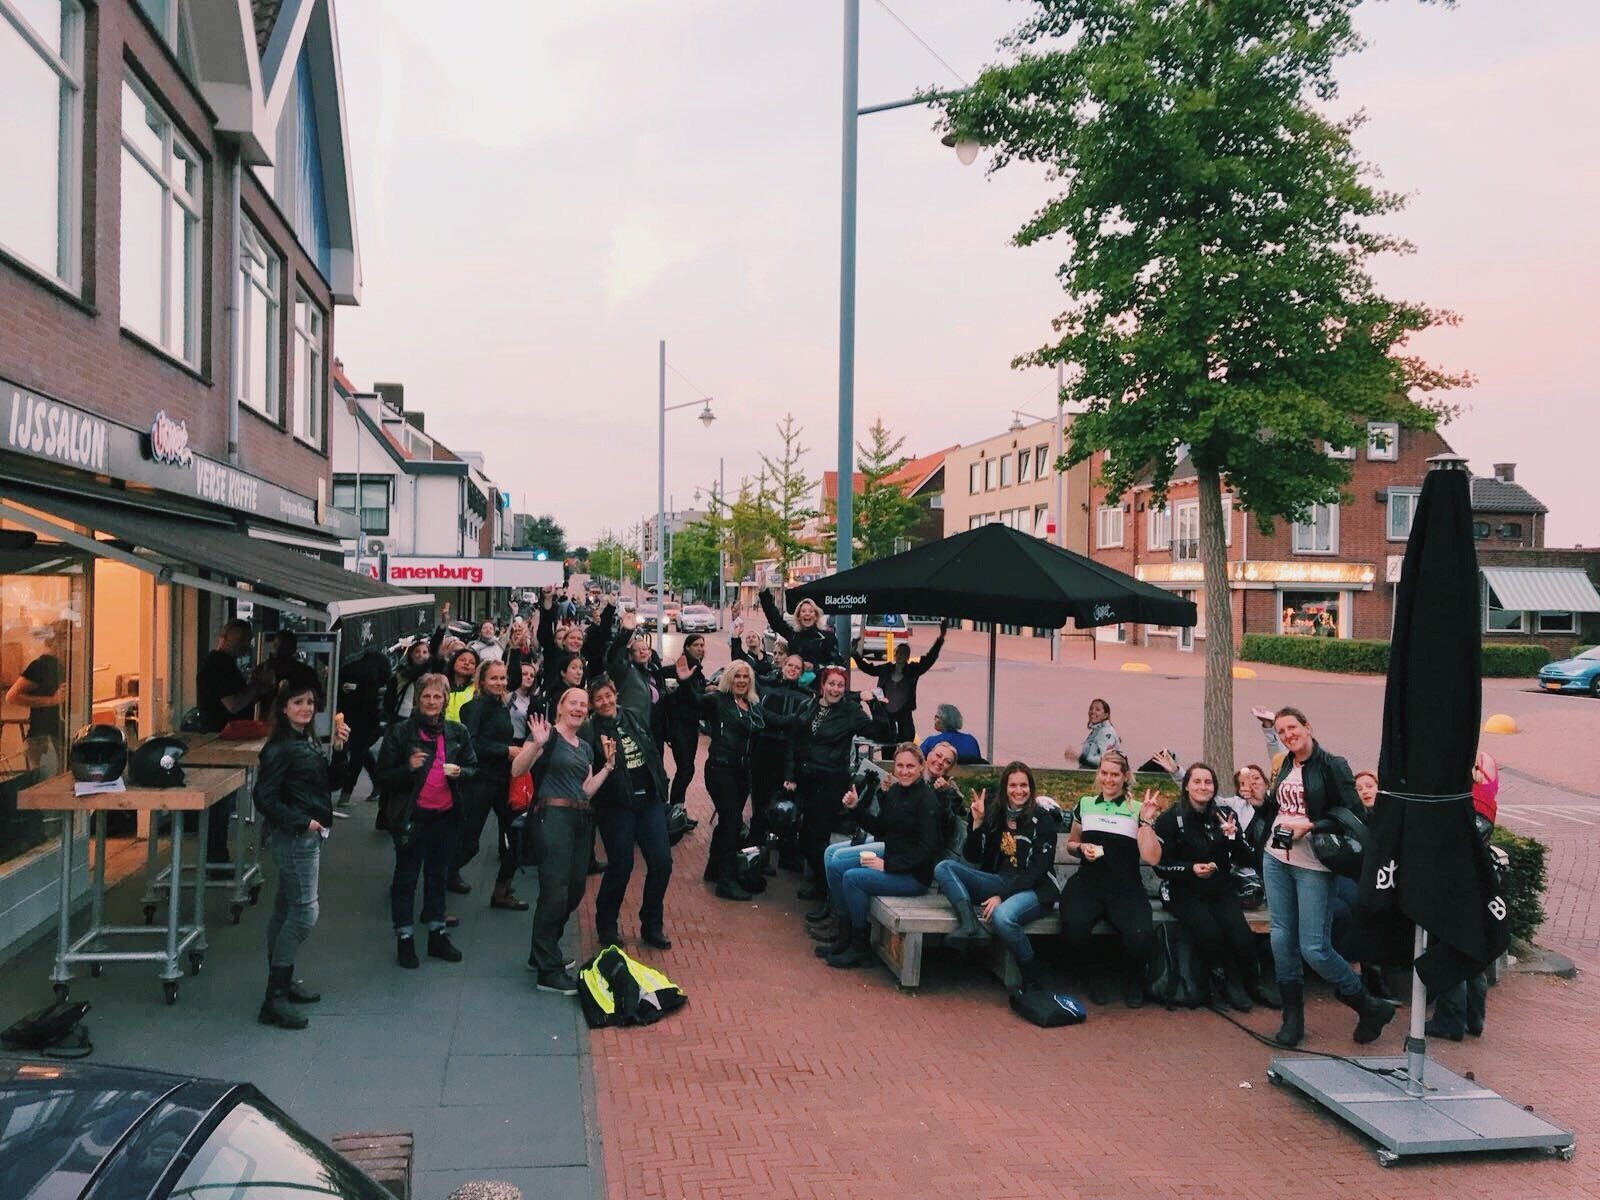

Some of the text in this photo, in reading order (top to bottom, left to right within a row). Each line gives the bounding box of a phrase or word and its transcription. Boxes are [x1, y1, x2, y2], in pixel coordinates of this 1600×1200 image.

[9, 391, 106, 469] IJSSALON
[196, 459, 226, 502] VERSE
[227, 471, 258, 511] KOFFIE
[391, 564, 483, 583] anenburg
[825, 594, 867, 605] BlackStock
